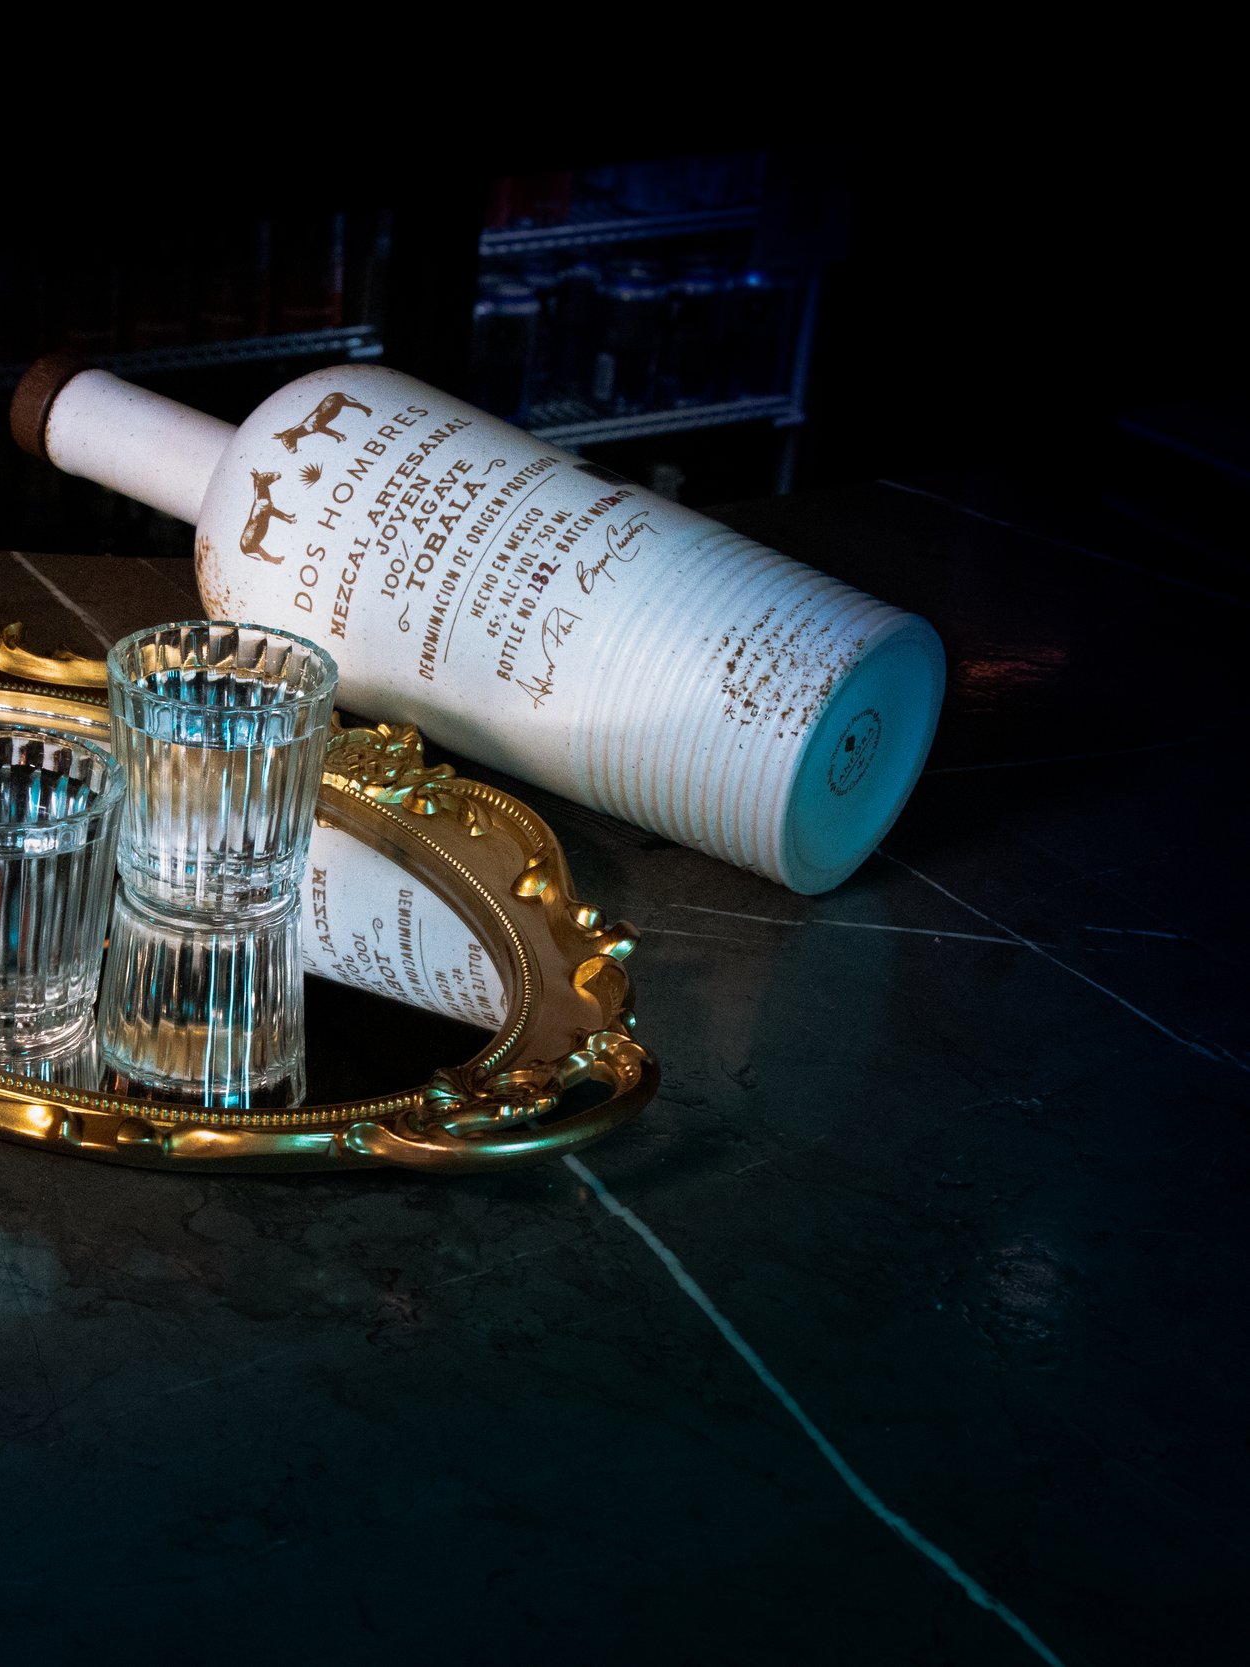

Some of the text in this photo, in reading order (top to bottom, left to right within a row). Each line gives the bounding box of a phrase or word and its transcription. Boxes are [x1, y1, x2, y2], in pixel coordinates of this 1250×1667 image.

[294, 405, 429, 613] DOS HOMBRES
[330, 417, 473, 640] MEZCAL ARTESANAL
[376, 473, 431, 555] JOVEN
[405, 480, 487, 591] TOBALA
[411, 459, 474, 535] AGAVE
[418, 456, 561, 681] DENOMINACION DE ORIGEN PROTEGIDA
[470, 507, 544, 619] HECHO EN MEXICO
[496, 621, 526, 682] BOTTLE
[555, 515, 595, 553] BATCH
[499, 552, 540, 608] ALC/VOL
[531, 524, 557, 549] 750
[551, 509, 573, 526] ML
